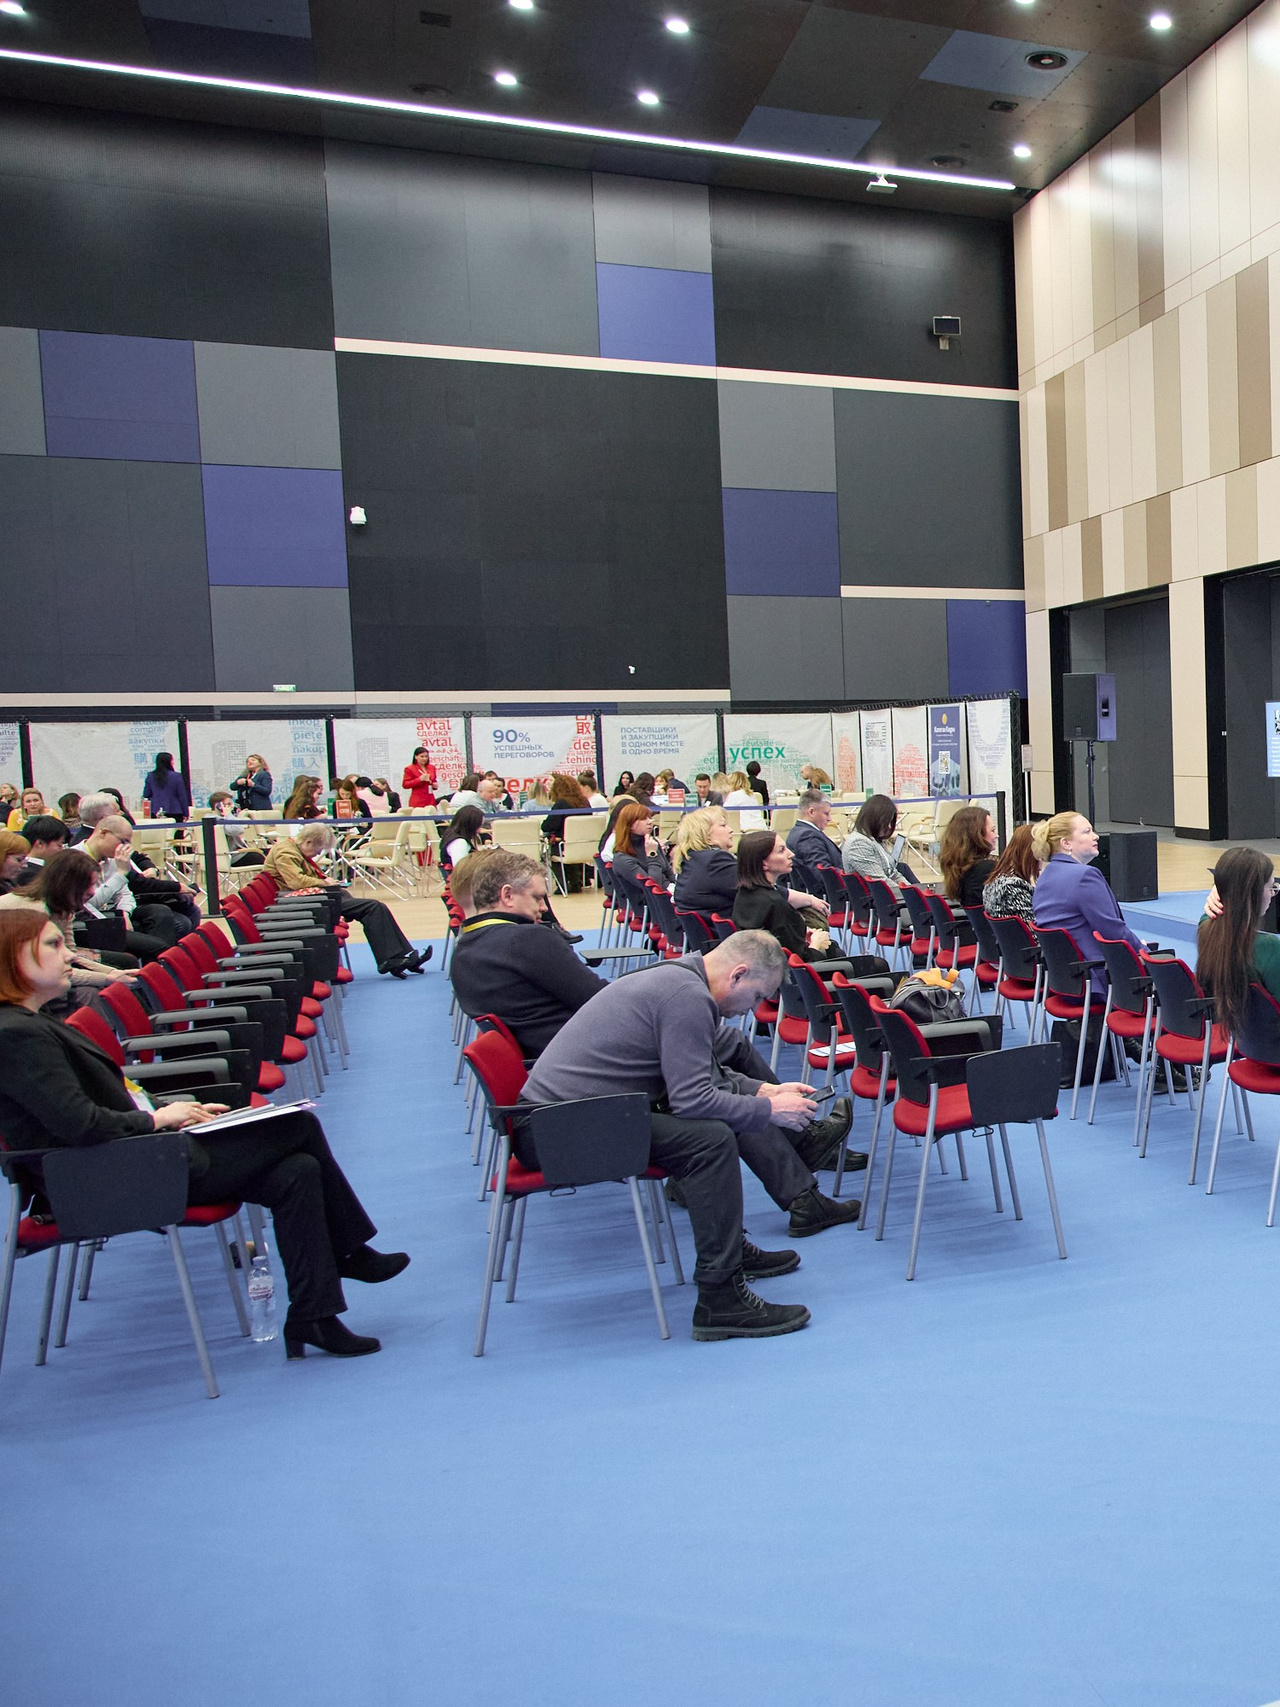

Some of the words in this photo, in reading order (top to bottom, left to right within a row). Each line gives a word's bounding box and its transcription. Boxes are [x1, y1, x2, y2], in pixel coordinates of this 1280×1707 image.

[417, 719, 451, 730] avtal
[621, 726, 677, 734] ПОСТАВЩИКИ
[492, 729, 531, 743] 90%
[628, 733, 679, 741] ЗАКУПЩИКИ
[422, 737, 453, 747] avtal
[573, 739, 597, 750] dea
[493, 744, 543, 752] УСПЕШНЫХ
[653, 747, 680, 755] ВРЕМЯ
[494, 751, 555, 759] ПЕРЕГОВОРОВ
[729, 746, 786, 764] успех
